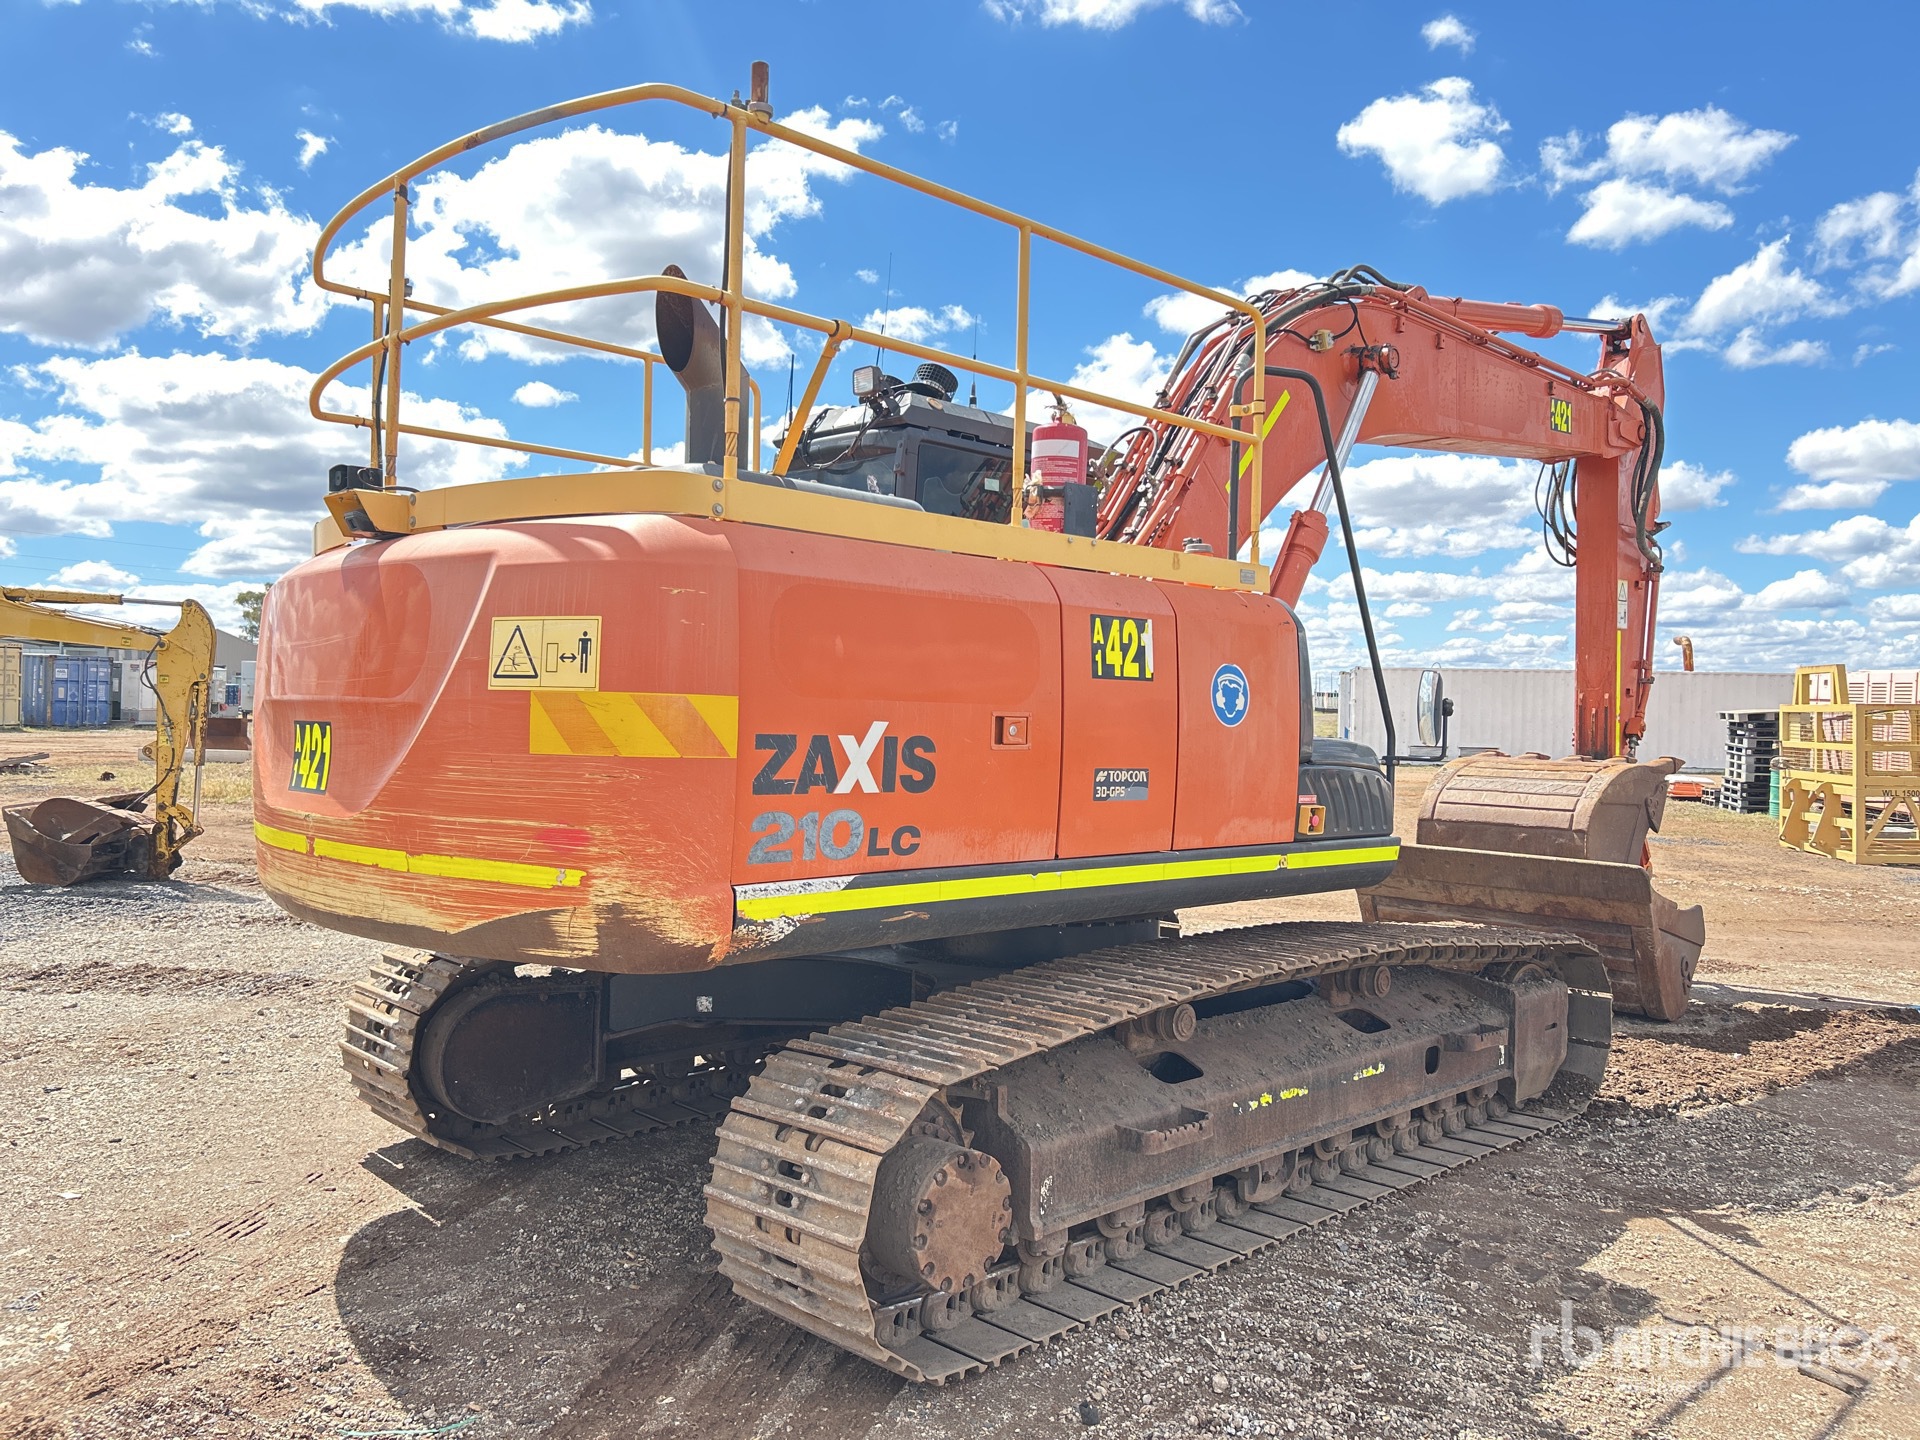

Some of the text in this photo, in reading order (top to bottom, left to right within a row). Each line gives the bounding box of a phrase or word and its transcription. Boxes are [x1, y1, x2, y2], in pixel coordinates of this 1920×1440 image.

[1555, 400, 1571, 433] 421
[298, 722, 331, 791] 421
[752, 720, 937, 796] ZAXIS
[1095, 785, 1126, 798] 3D-GPS
[1108, 770, 1148, 783] TOPCON
[1881, 789, 1900, 797] WLL
[746, 808, 921, 866] 210 LC
